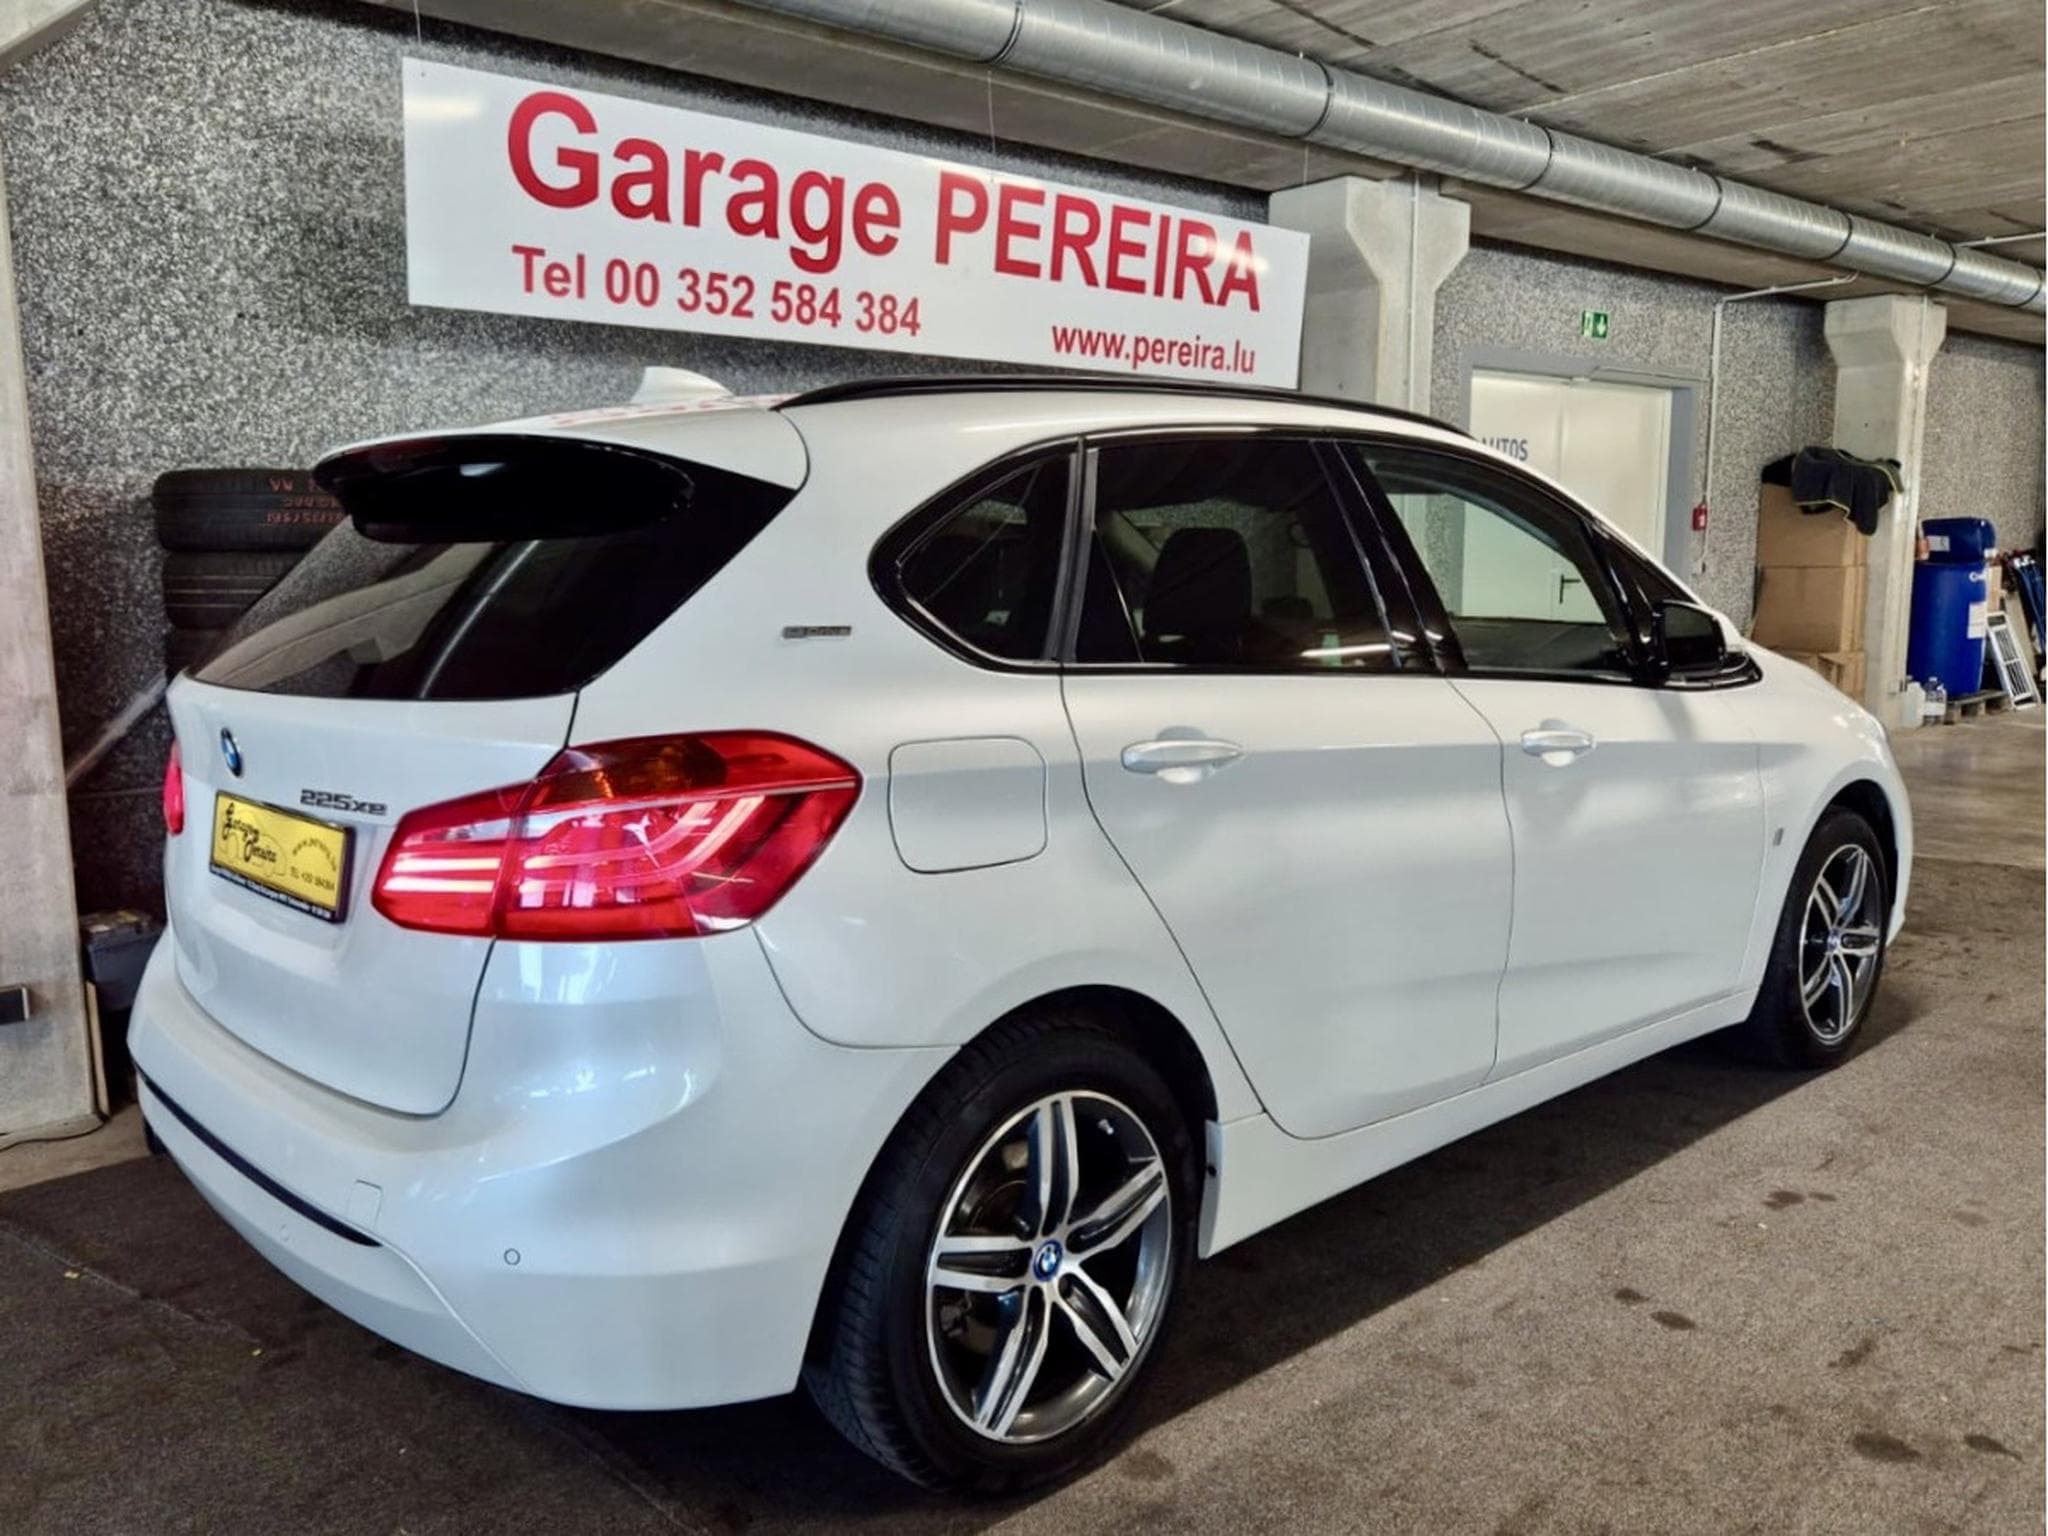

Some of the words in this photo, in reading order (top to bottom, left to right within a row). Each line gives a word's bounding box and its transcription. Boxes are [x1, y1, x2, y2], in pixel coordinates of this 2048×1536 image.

[507, 91, 903, 276] Garage
[935, 172, 1261, 313] PEREIRA
[512, 245, 587, 300] Tel
[604, 258, 661, 309] 00
[678, 268, 756, 320] 352
[771, 280, 842, 328] 584
[856, 292, 921, 336] 384
[1053, 327, 1255, 373] www.pereira.lu
[300, 788, 387, 816] 225xe
